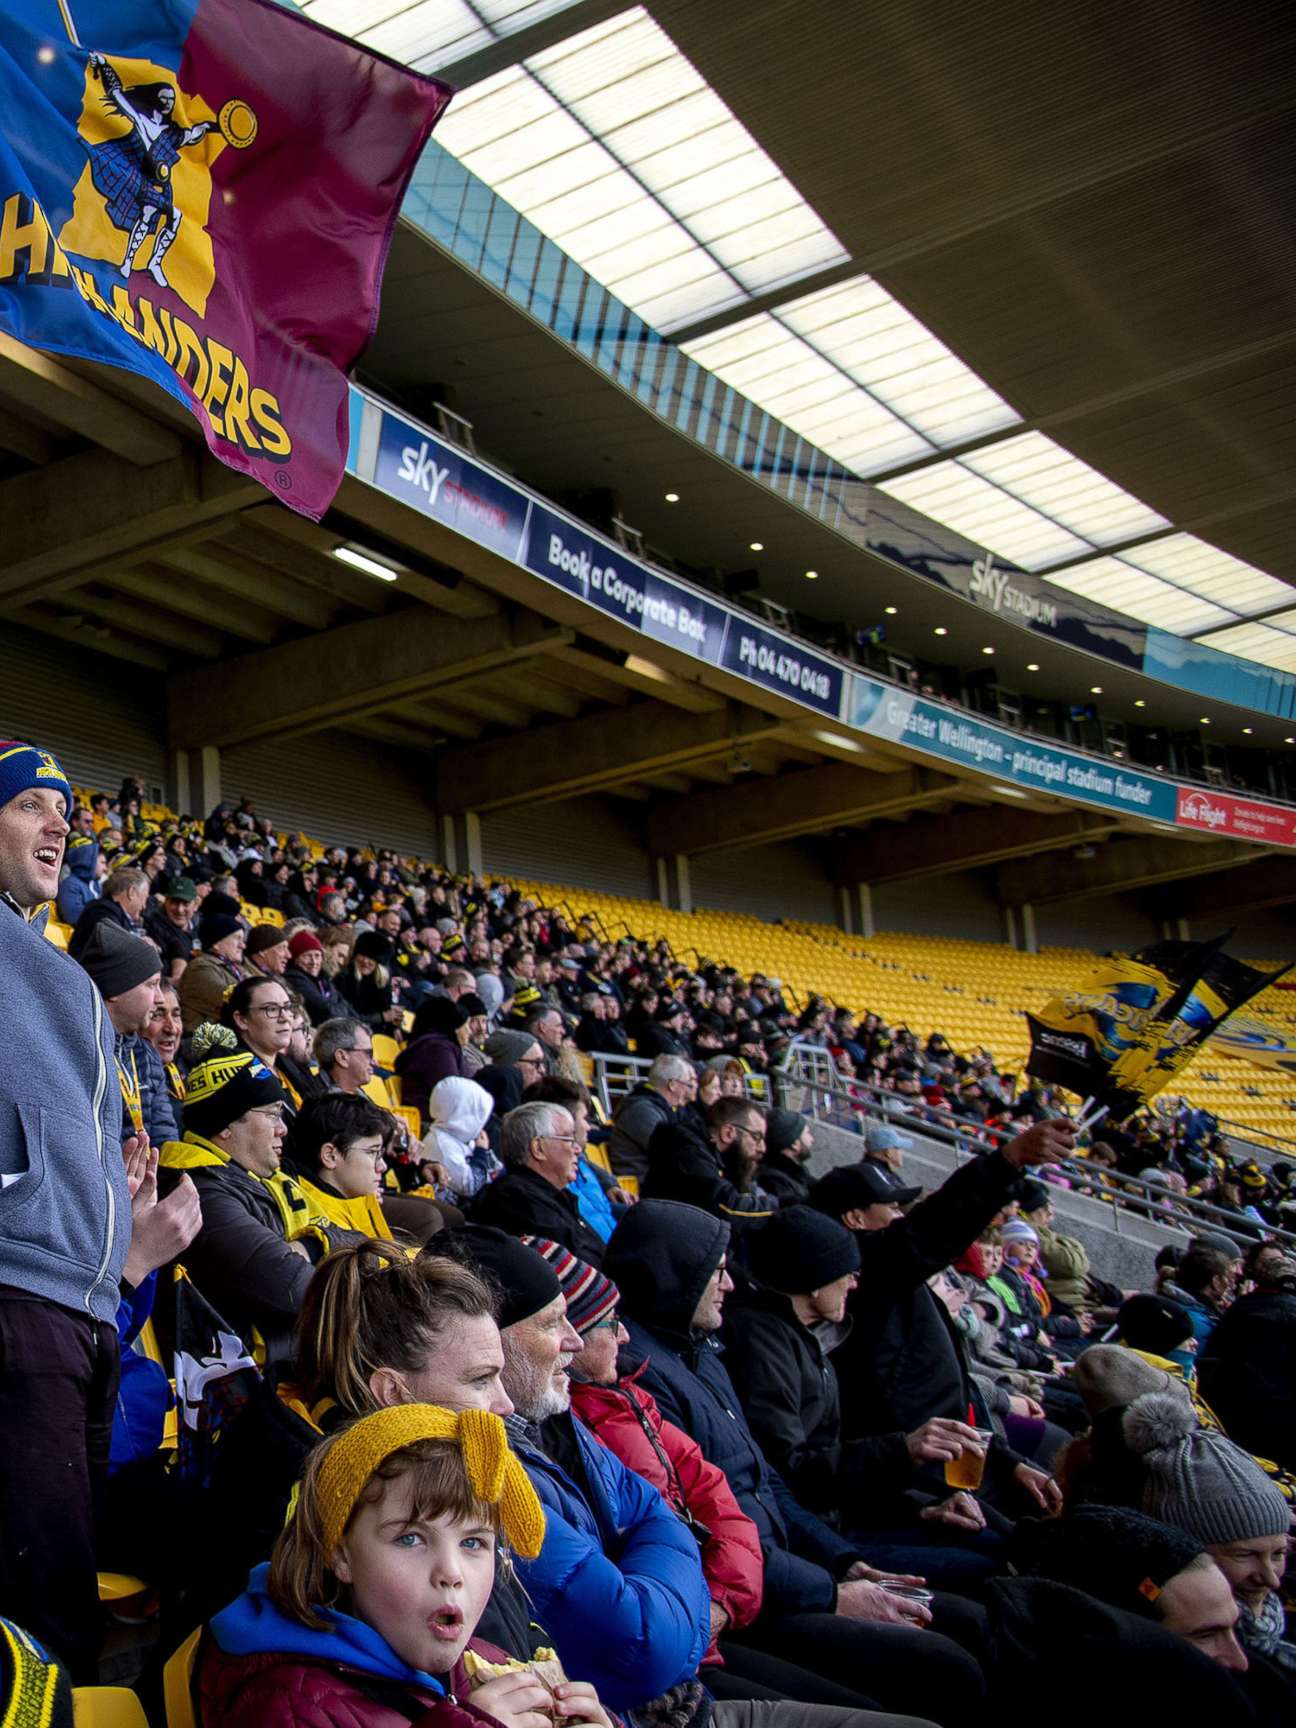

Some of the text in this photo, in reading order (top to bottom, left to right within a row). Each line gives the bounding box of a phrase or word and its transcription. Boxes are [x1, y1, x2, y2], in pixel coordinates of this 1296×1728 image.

[397, 441, 450, 505] sky
[548, 533, 706, 642] Book a Corporate Box
[968, 553, 1058, 629] sky STADIUM
[739, 636, 831, 701] Ph 04 470 0418
[886, 701, 938, 740] Greater
[938, 718, 1003, 764] Wellington
[1012, 750, 1068, 785] principal
[1067, 766, 1114, 796] stadium
[1114, 775, 1153, 806] funder
